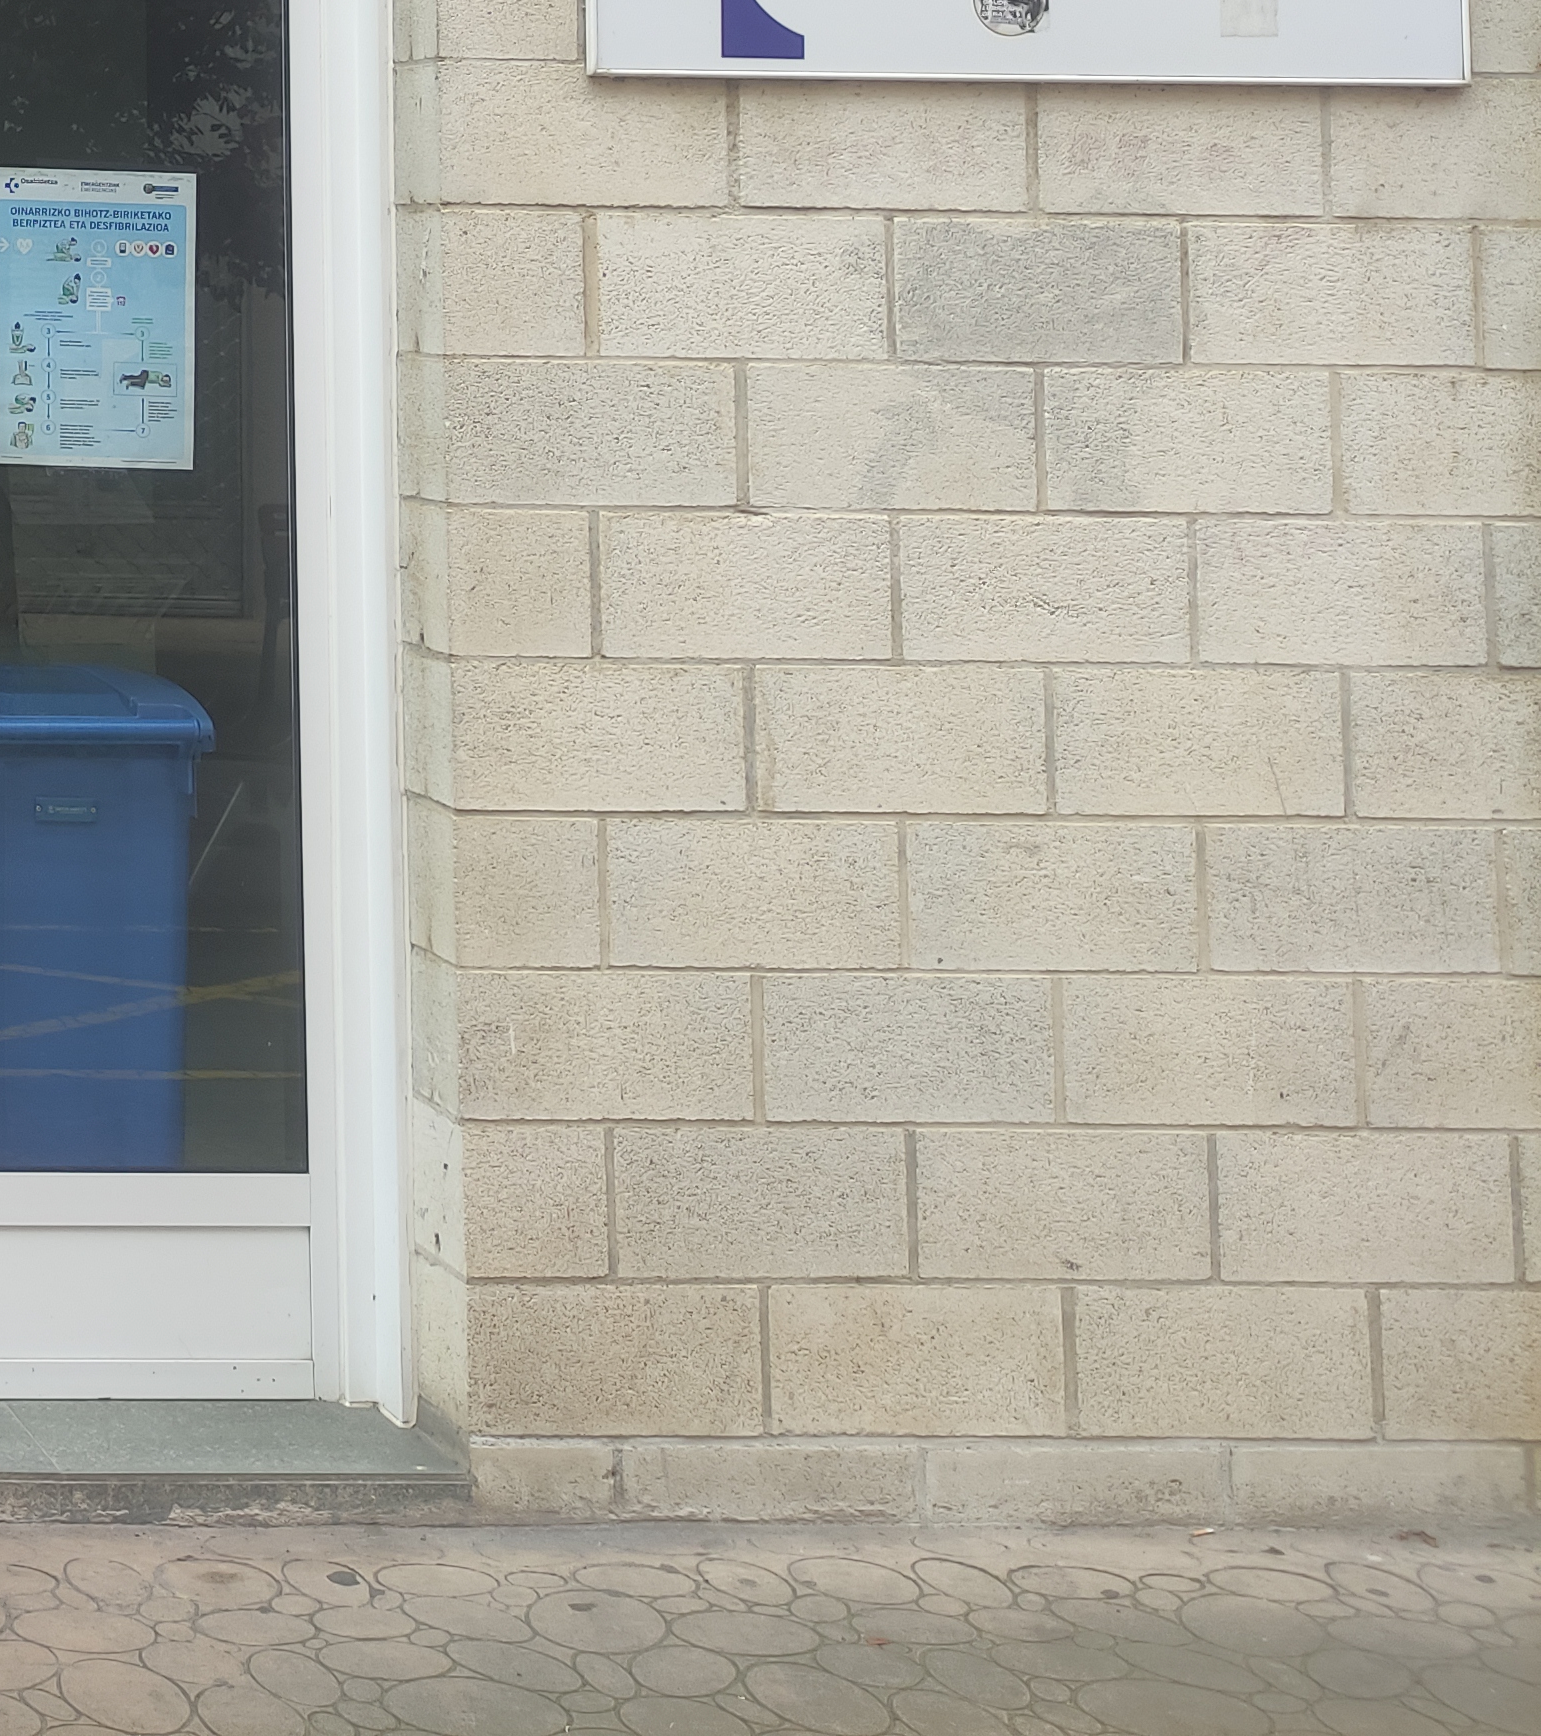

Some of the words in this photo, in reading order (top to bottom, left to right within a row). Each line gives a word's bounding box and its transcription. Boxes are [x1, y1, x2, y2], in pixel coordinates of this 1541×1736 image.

[10, 206, 71, 217] OINARRIZKO
[74, 209, 172, 220] BIHOTZ-BIRIKETAKO
[12, 218, 66, 229] BERPIZTEA
[70, 220, 87, 229] ETA
[90, 221, 169, 232] DESFIBRILAZIOA
